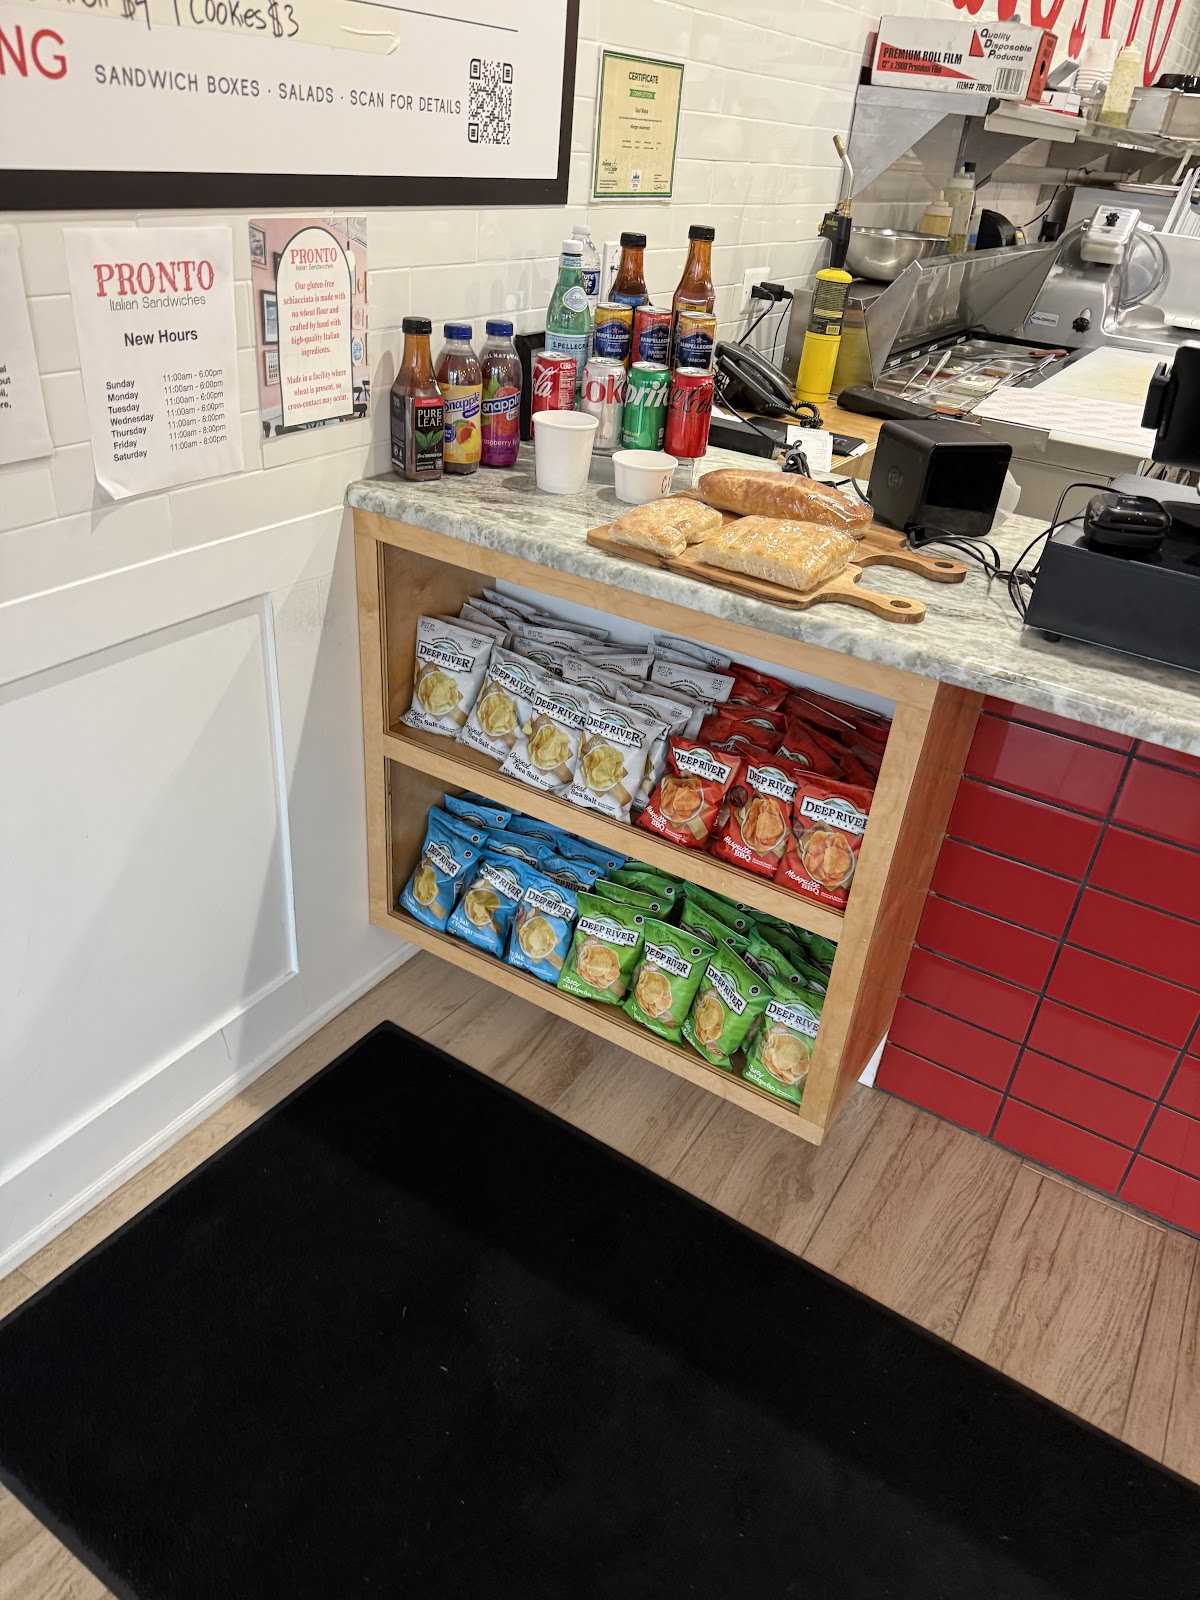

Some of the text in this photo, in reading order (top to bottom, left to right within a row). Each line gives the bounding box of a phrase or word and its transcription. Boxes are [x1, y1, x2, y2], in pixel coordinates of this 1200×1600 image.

[980, 29, 1011, 41] Quality
[984, 39, 1032, 52] Disposable
[883, 48, 962, 64] PREMIUM ROLL FILM
[988, 50, 1023, 61] Products
[629, 72, 659, 84] CERTIFICATE
[95, 64, 461, 114] SANDWICH BOXES SALADS SCAN FOR DETAILS
[290, 248, 337, 264] PRONTO
[93, 260, 215, 297] PRONTO
[295, 280, 334, 291] Our gluten-free
[109, 295, 206, 312] Italian Sandwiches
[320, 293, 333, 301] made
[330, 305, 338, 314] and
[290, 322, 308, 331] crafted
[310, 321, 315, 331] by
[317, 320, 329, 328] hand
[124, 328, 198, 346] New Hours
[324, 332, 339, 340] Italian
[163, 369, 222, 382] 11:00am 6:00pm
[287, 375, 301, 384] Made
[313, 371, 330, 380] facility
[106, 379, 135, 391] Sunday
[164, 385, 193, 394] 11:00am
[107, 391, 139, 402] Monday
[166, 396, 194, 405] 11:00am
[108, 403, 140, 415] Tuesday
[167, 408, 195, 417] 11:00am
[418, 409, 442, 418] PURE
[110, 413, 154, 426] Wednesday
[168, 419, 196, 428] 11:00am
[418, 418, 442, 427] LEAF
[111, 426, 147, 438] Thursday
[170, 425, 226, 440] 11:00am 8:00pm
[114, 438, 138, 449] Friday
[170, 435, 227, 451] 11:00am 8:00pm
[114, 449, 147, 461] Saturday
[420, 645, 470, 668] DEEP RIVER
[492, 663, 510, 680] DEEP
[535, 696, 586, 727] DEEP RIVER
[610, 725, 640, 743] RIVER
[478, 738, 490, 748] Salt
[673, 751, 726, 779] DEEP RIVER
[515, 764, 539, 783] Sea Salt
[749, 770, 768, 786] DEEP
[584, 793, 597, 804] Salt
[804, 801, 834, 817] DEEP
[734, 849, 751, 863] BBQ
[500, 878, 521, 898] RIVER
[528, 890, 571, 918] DEEP RIVER
[580, 920, 635, 943] DEEP RIVER
[665, 955, 688, 973] RIVER
[707, 966, 743, 1010] DEEP RIVER
[768, 1003, 819, 1031] DEEP RIVE
